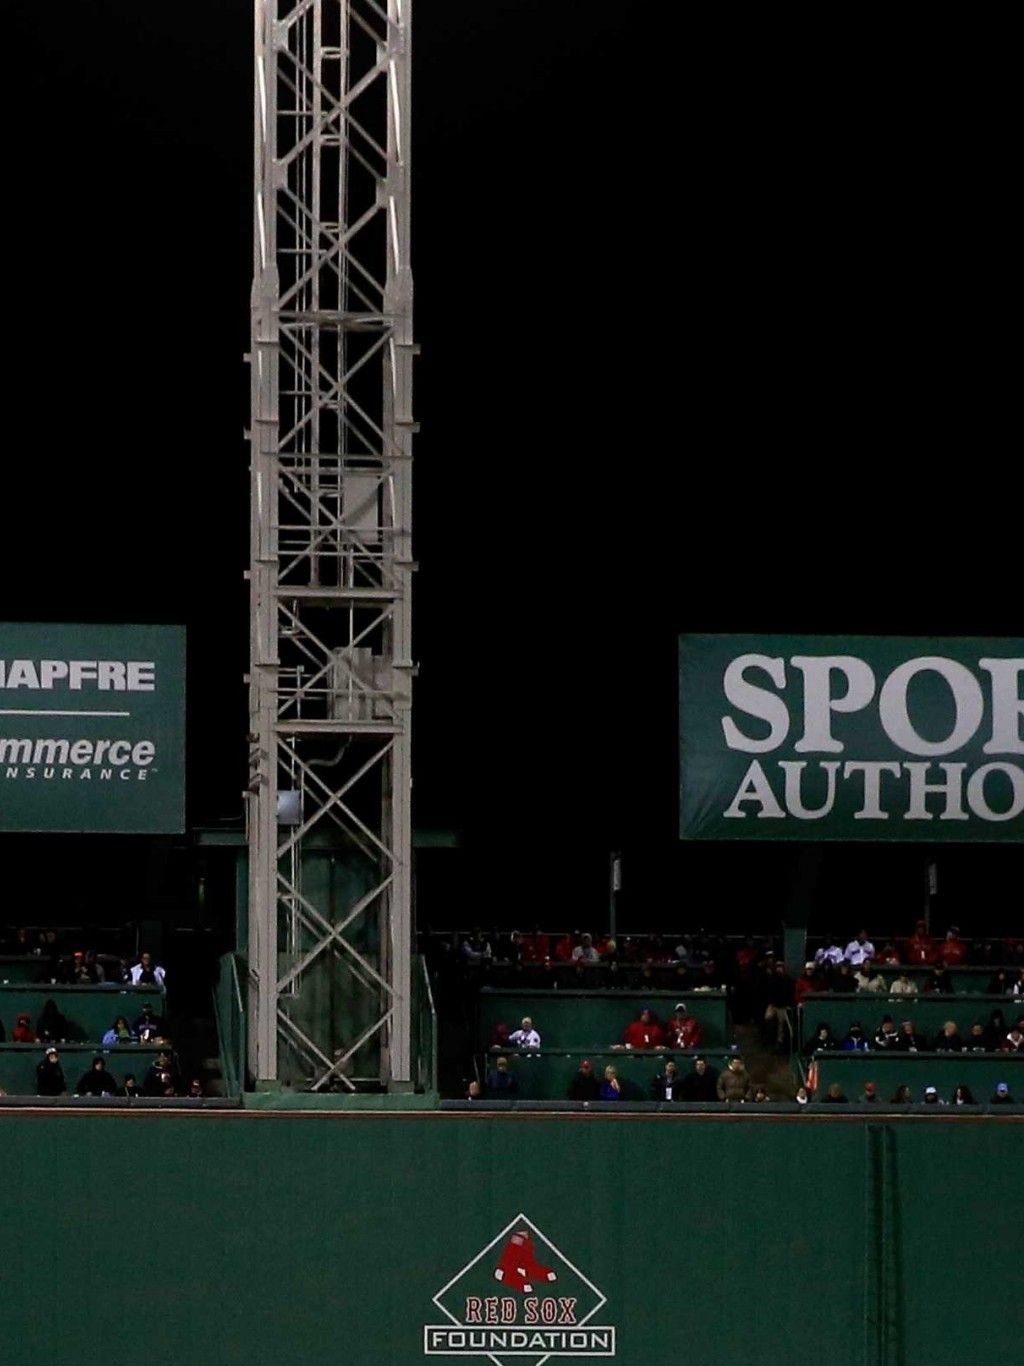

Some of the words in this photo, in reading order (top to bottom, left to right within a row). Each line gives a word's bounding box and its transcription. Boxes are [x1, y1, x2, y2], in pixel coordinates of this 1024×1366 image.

[466, 1297, 517, 1324] RED
[524, 1297, 576, 1324] SOX
[432, 1332, 608, 1348] FOUNDATION
